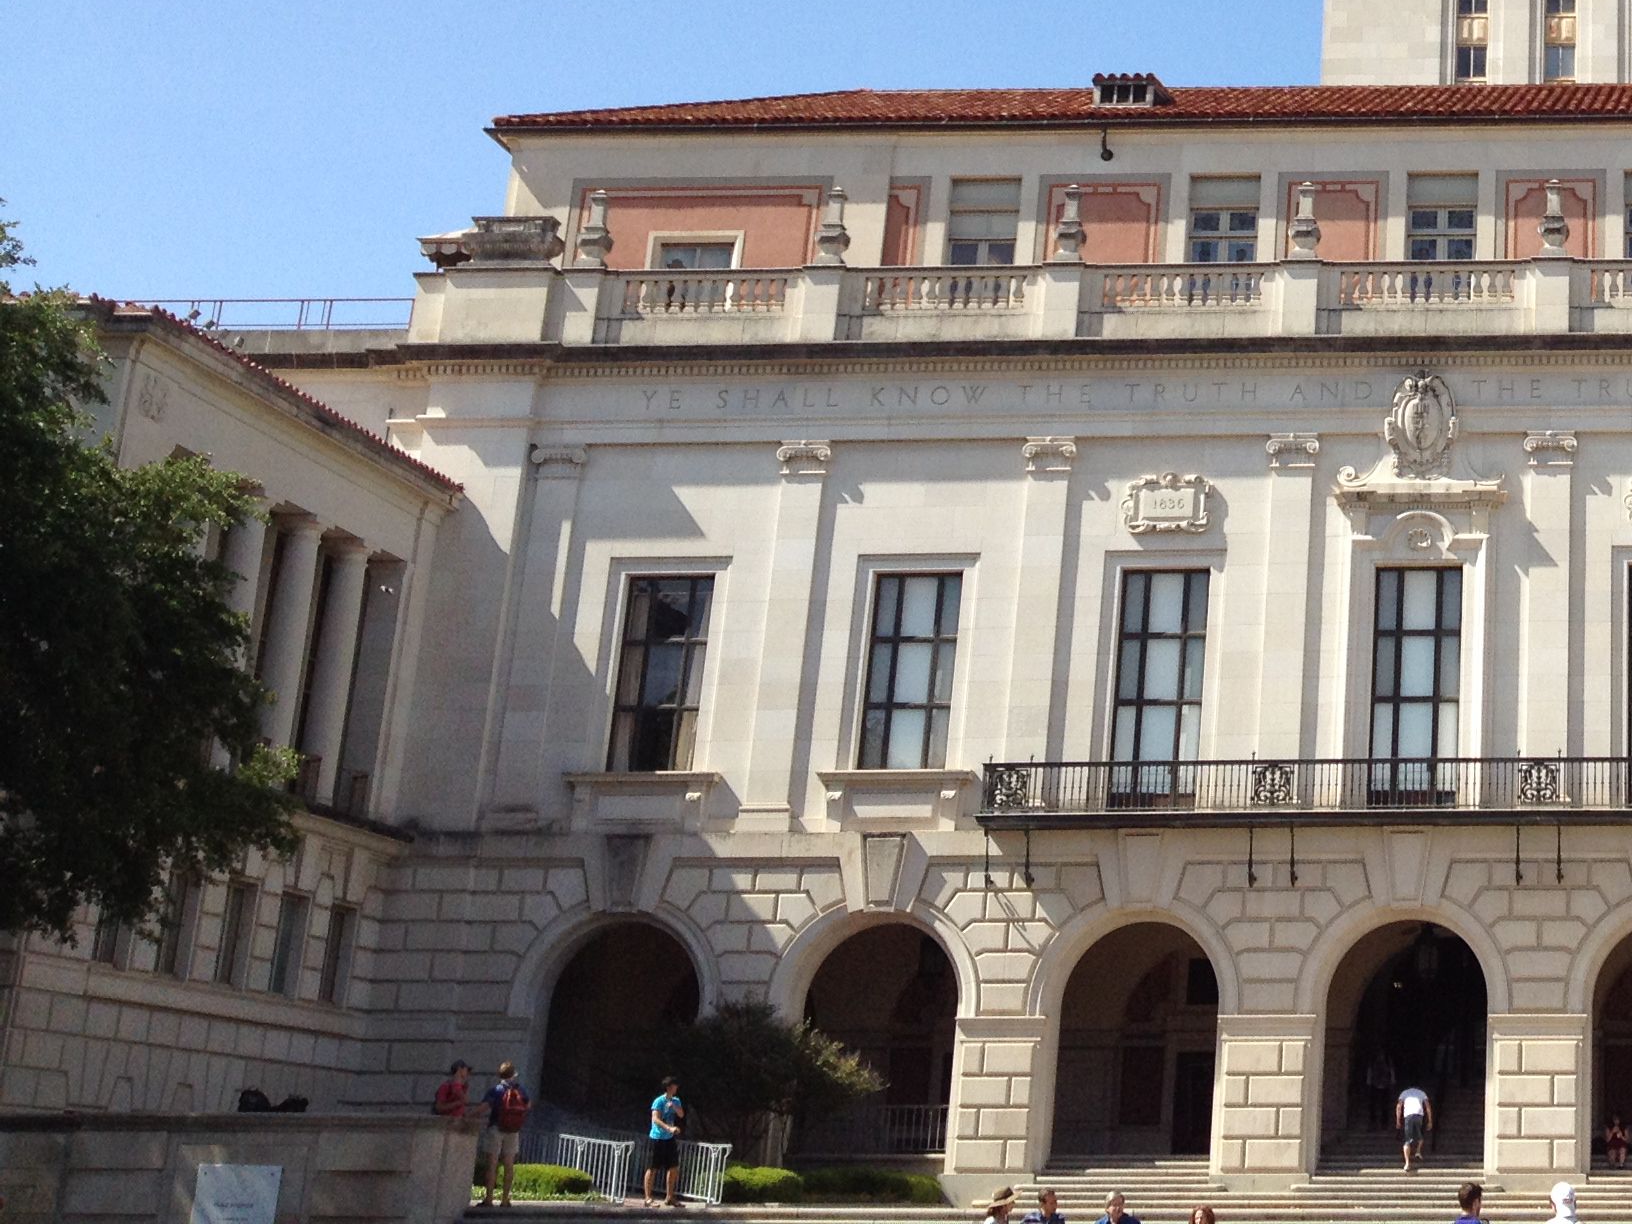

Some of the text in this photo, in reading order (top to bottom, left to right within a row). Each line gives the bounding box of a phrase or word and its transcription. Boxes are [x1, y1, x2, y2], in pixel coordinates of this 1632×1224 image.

[643, 390, 682, 410] YE
[715, 388, 841, 409] SHALL
[869, 385, 987, 406] KNOW
[1017, 384, 1091, 404] THE
[1124, 381, 1257, 402] TRUTH
[1288, 380, 1373, 401] AND
[1472, 378, 1542, 399] THE
[1153, 498, 1185, 510] 1836
